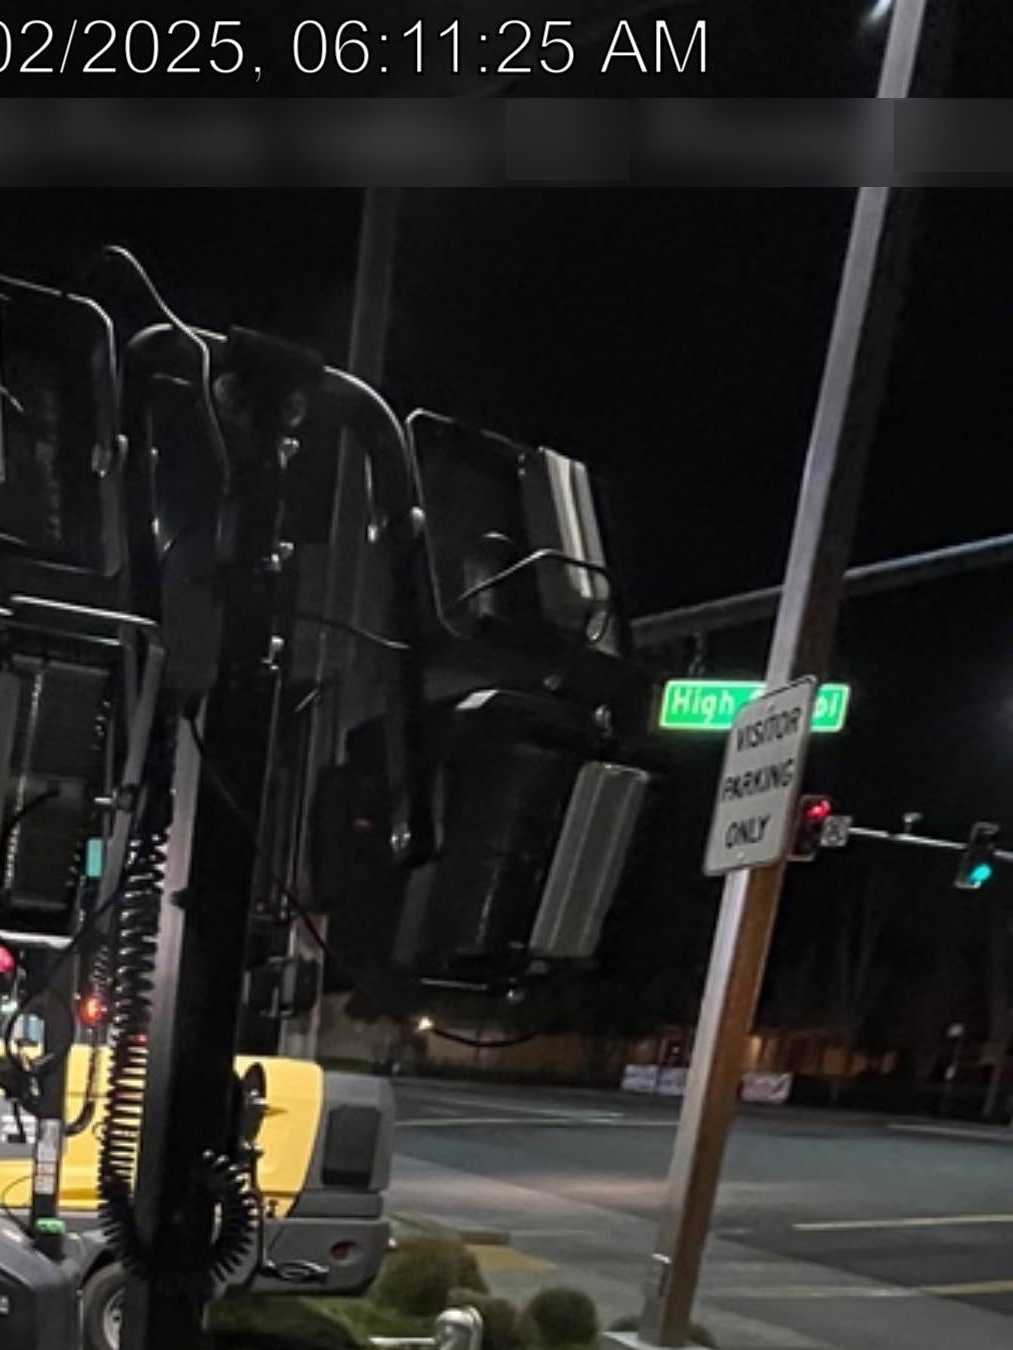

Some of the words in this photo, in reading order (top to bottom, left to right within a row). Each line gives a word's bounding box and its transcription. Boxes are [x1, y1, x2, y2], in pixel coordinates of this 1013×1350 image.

[671, 687, 735, 722] High
[737, 707, 801, 752] VISITOR
[723, 759, 794, 800] PARKING
[725, 815, 770, 849] ONLY
